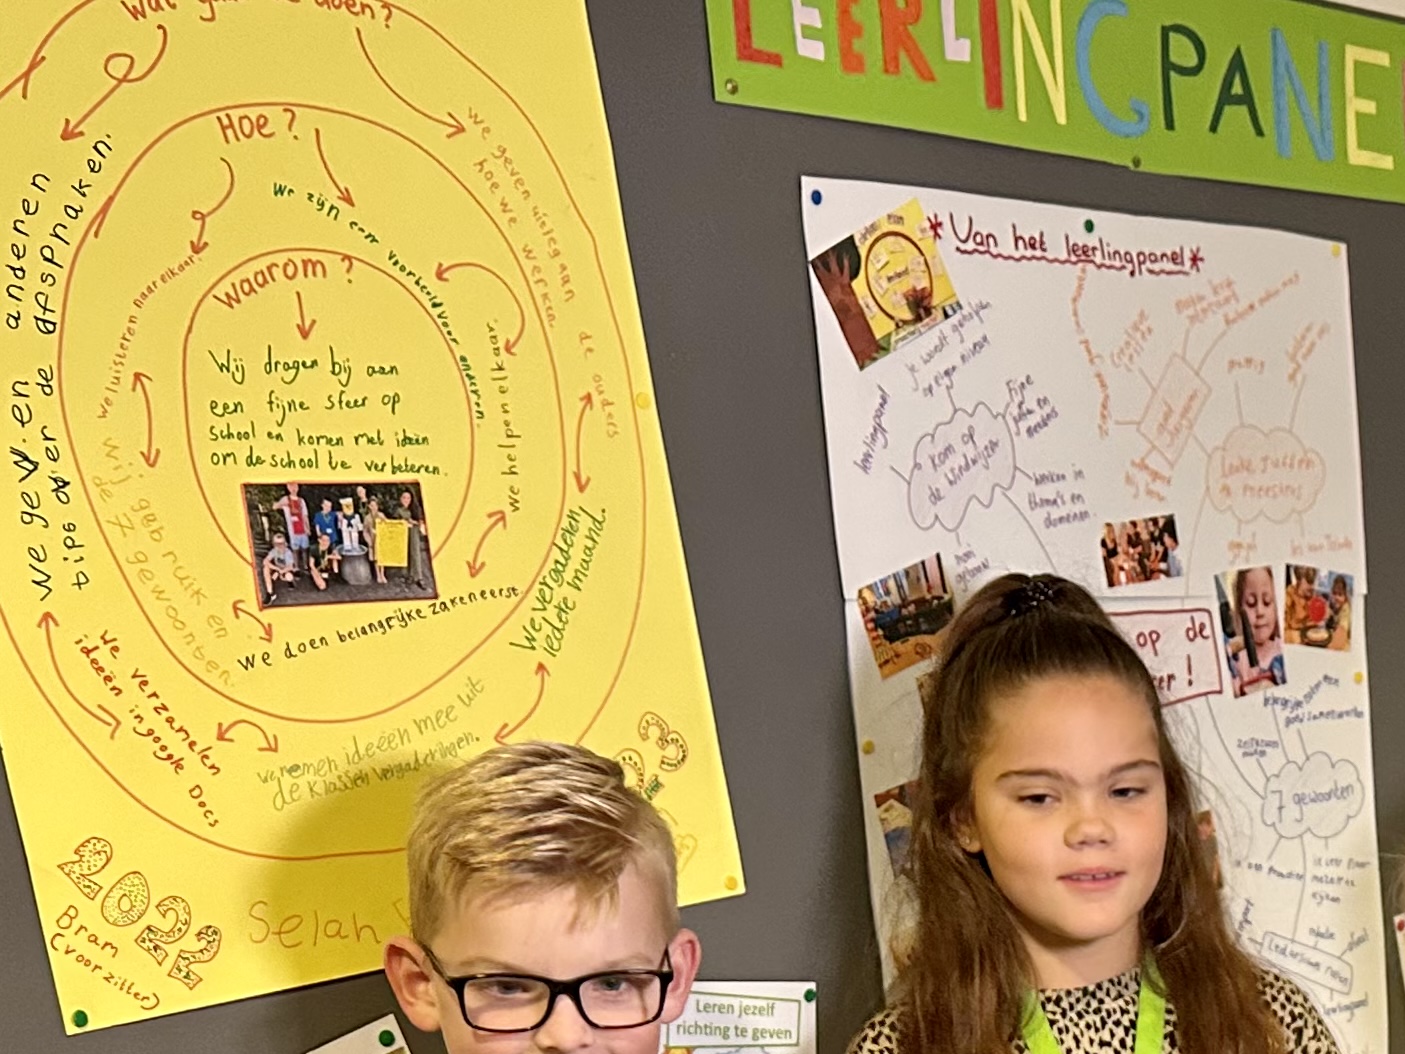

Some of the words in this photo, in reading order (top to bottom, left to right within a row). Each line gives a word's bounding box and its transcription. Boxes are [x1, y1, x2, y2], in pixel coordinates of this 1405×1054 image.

[950, 212, 999, 249] Van
[1011, 223, 1048, 252] het
[1064, 234, 1185, 277] leerlingpanel
[35, 365, 54, 397] de
[208, 348, 245, 385] Wij
[264, 345, 319, 384] dragen
[329, 344, 352, 387] bij
[366, 364, 399, 377] aan
[209, 398, 244, 417] een
[267, 390, 310, 426] fijne
[325, 391, 368, 410] sfeer
[381, 393, 401, 415] op
[210, 451, 238, 466] om
[246, 444, 267, 468] de
[269, 448, 319, 470] school
[328, 451, 352, 470] te
[266, 430, 284, 443] en
[296, 429, 344, 447] komen
[354, 428, 384, 446] met
[497, 403, 522, 477] helpen
[63, 521, 90, 590] tips
[284, 634, 329, 659] doen
[509, 614, 542, 652] We
[1136, 629, 1161, 657] op
[1185, 615, 1210, 643] de
[129, 706, 145, 724] in
[188, 784, 220, 828] Docs
[55, 904, 119, 958] Bram
[57, 836, 223, 991] 2022
[248, 899, 382, 949] Selah
[49, 932, 161, 1010] (voorzitter)
[696, 999, 735, 1015] Leren
[738, 1001, 776, 1018] jezelf
[676, 1022, 730, 1040] richting
[734, 1025, 748, 1038] te
[751, 1026, 793, 1041] geven
